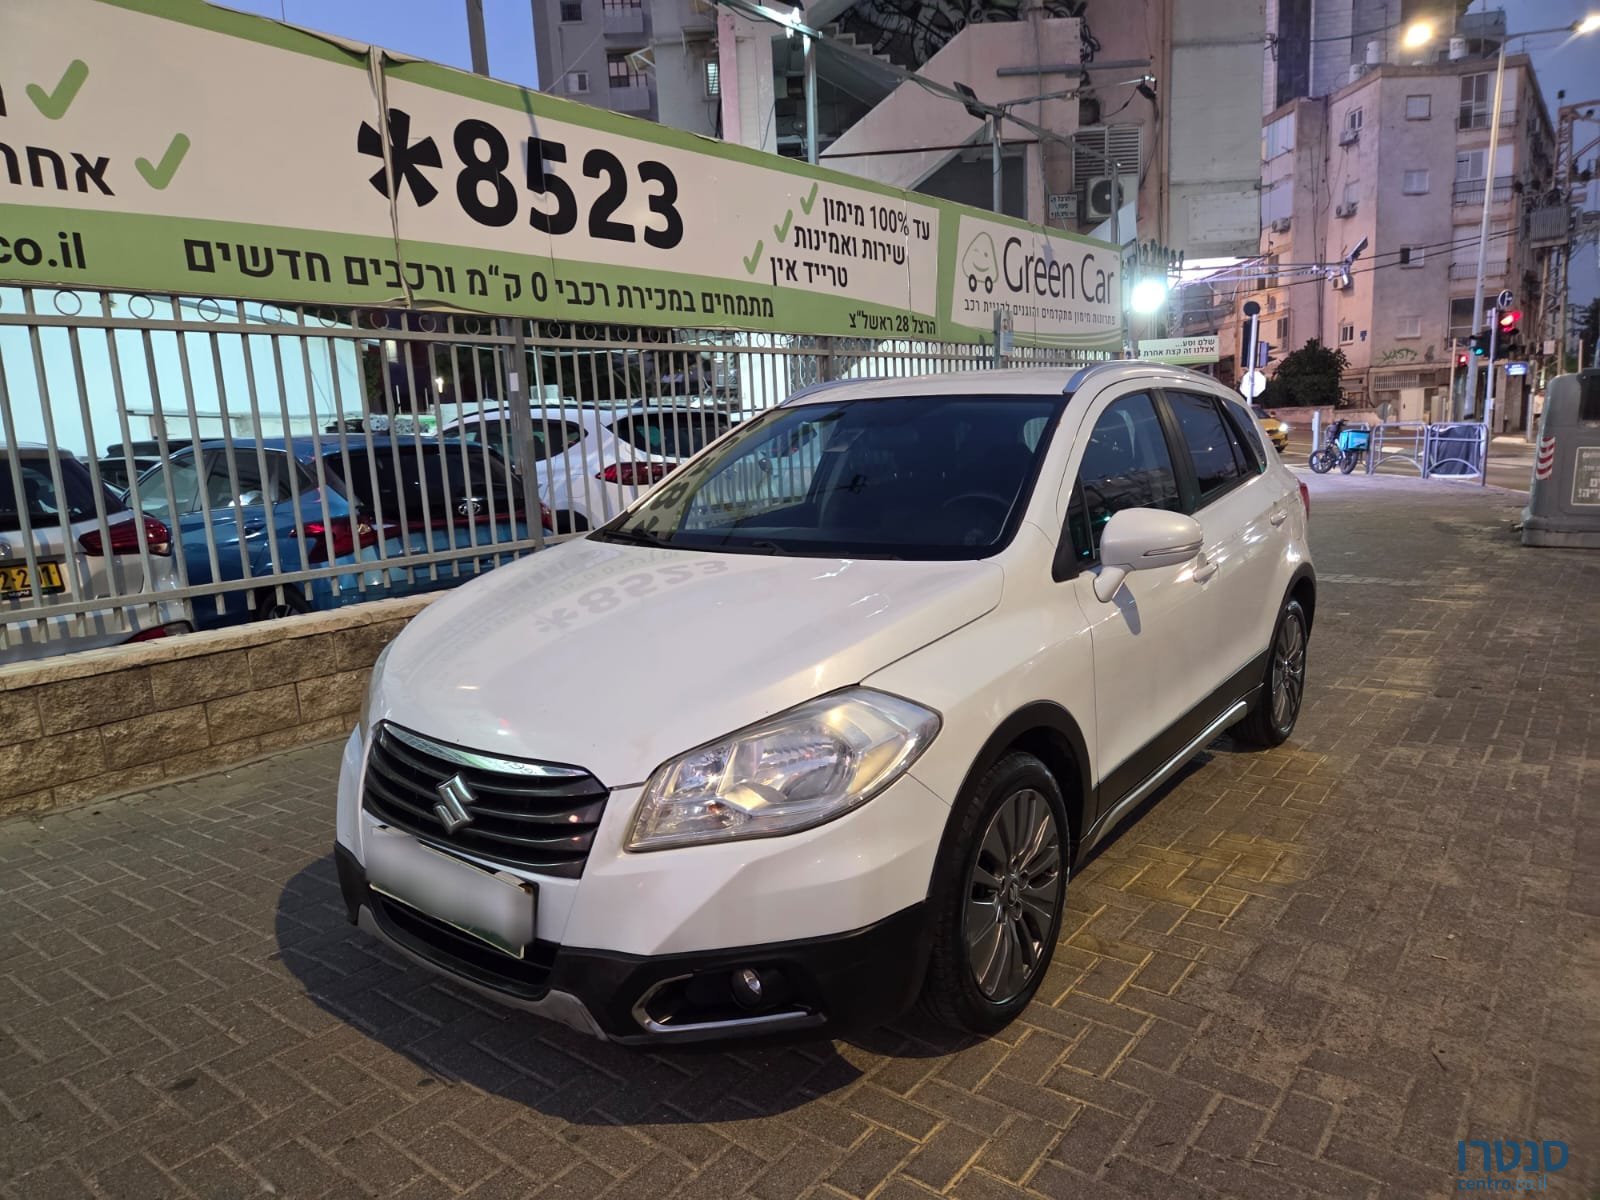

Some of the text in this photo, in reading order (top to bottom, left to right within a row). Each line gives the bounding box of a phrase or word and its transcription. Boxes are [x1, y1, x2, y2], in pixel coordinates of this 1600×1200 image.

[823, 197, 930, 240] עד 100% מימון
[184, 238, 332, 283] חדשים
[794, 225, 905, 265] שירות ואמינות
[344, 255, 456, 294] ורכבים
[770, 256, 848, 287] טרייד אין
[1003, 236, 1114, 305] Green Car
[531, 271, 548, 302] 0
[555, 279, 610, 307] רכבי
[617, 284, 696, 312] במכירת
[702, 292, 774, 318] מתמחים
[964, 298, 980, 312] רכב
[896, 314, 909, 332] 28
[912, 315, 936, 335] הרצל
